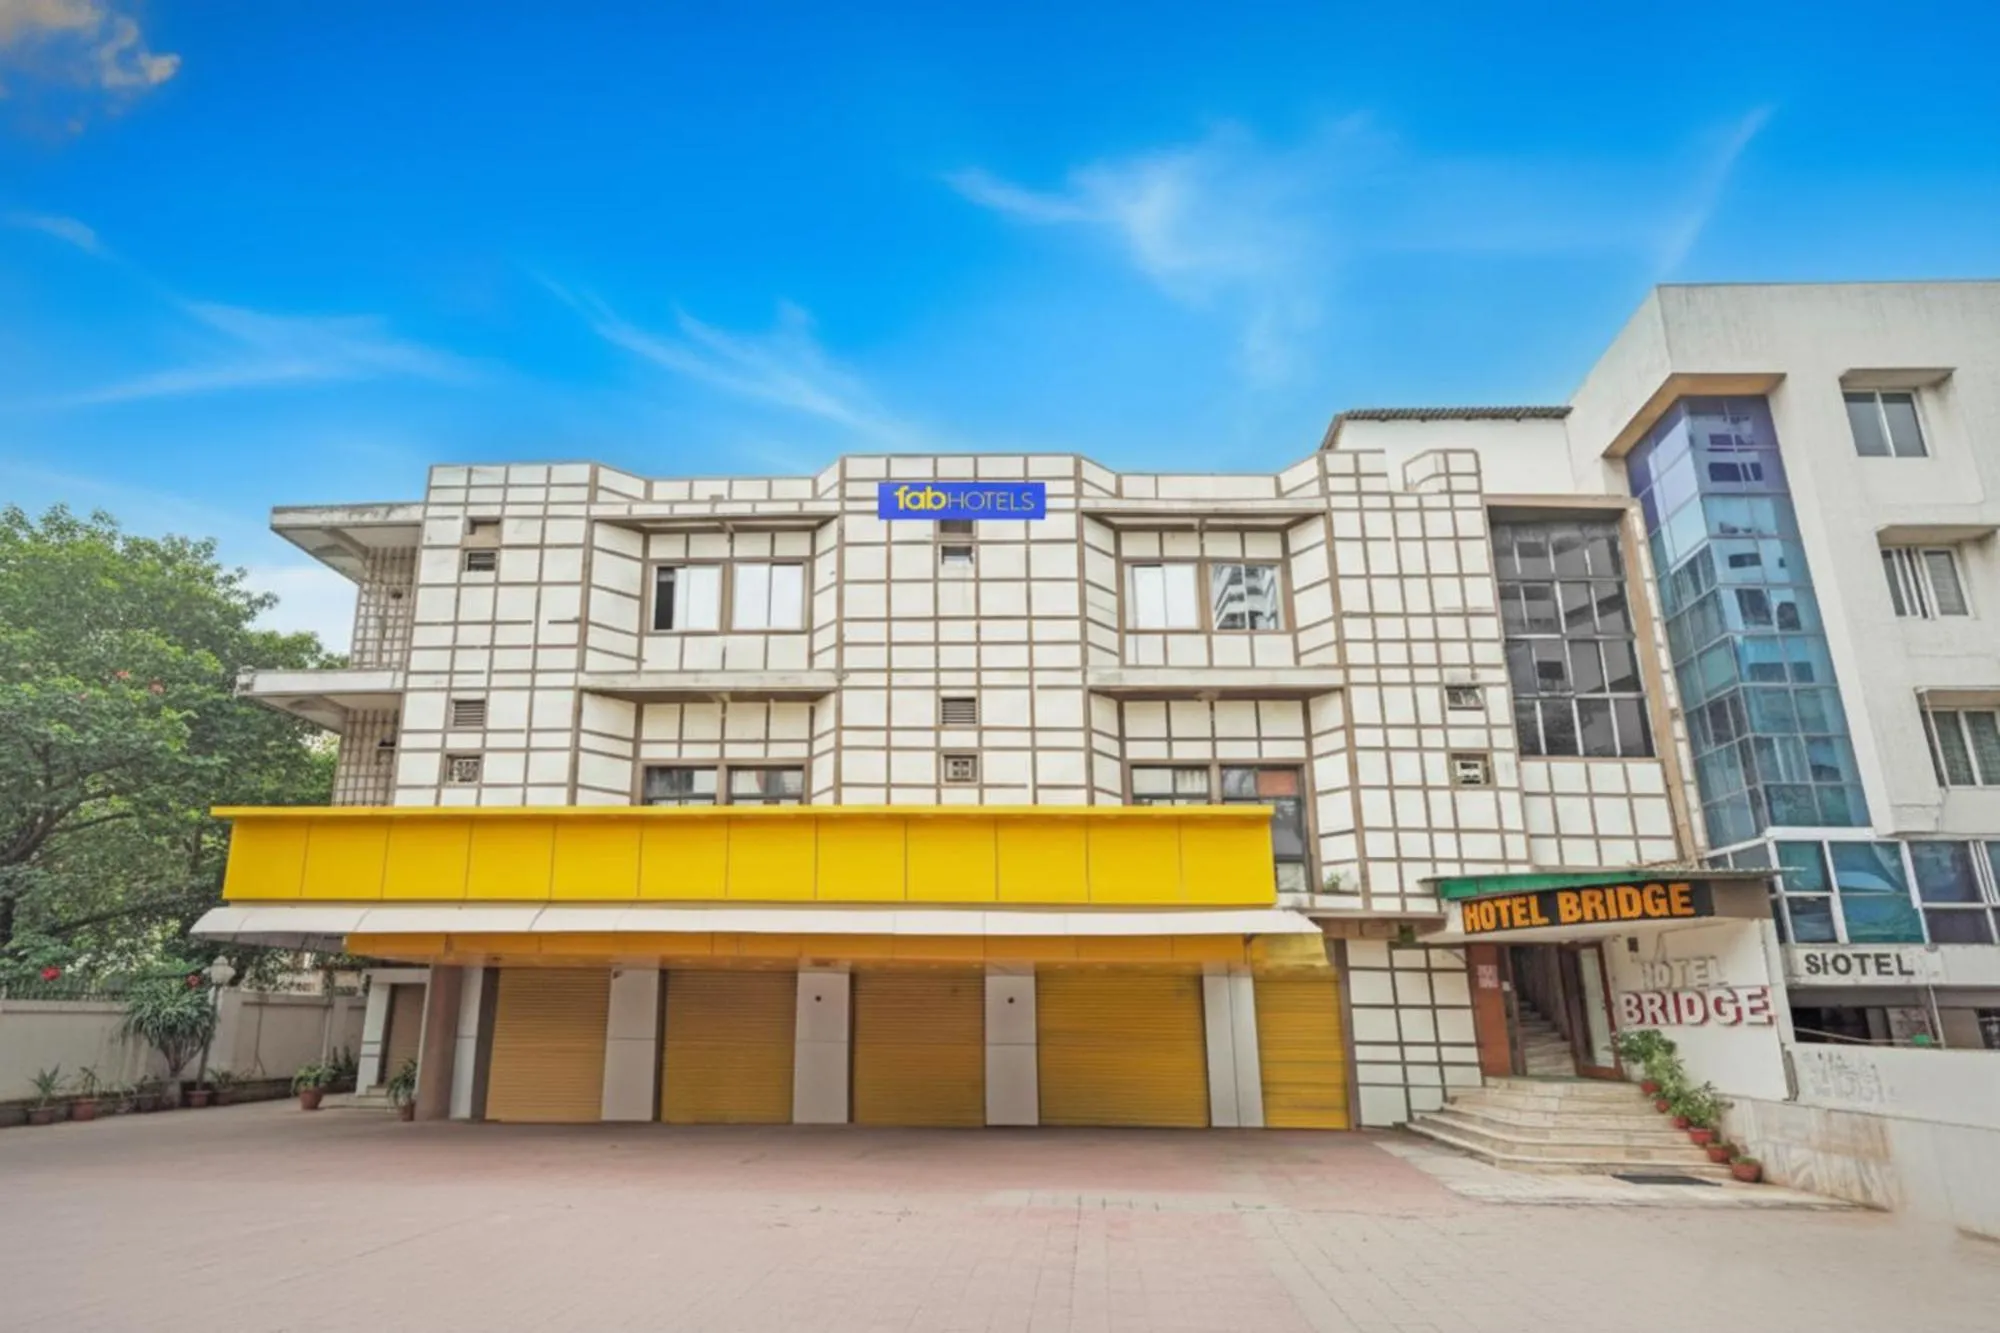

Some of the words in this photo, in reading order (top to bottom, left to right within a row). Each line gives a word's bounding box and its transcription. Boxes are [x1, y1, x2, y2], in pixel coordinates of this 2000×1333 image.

[1463, 895, 1549, 932] HOTEL
[1557, 883, 1695, 925] BRIDGE
[1618, 986, 1775, 1027] BRIDGE
